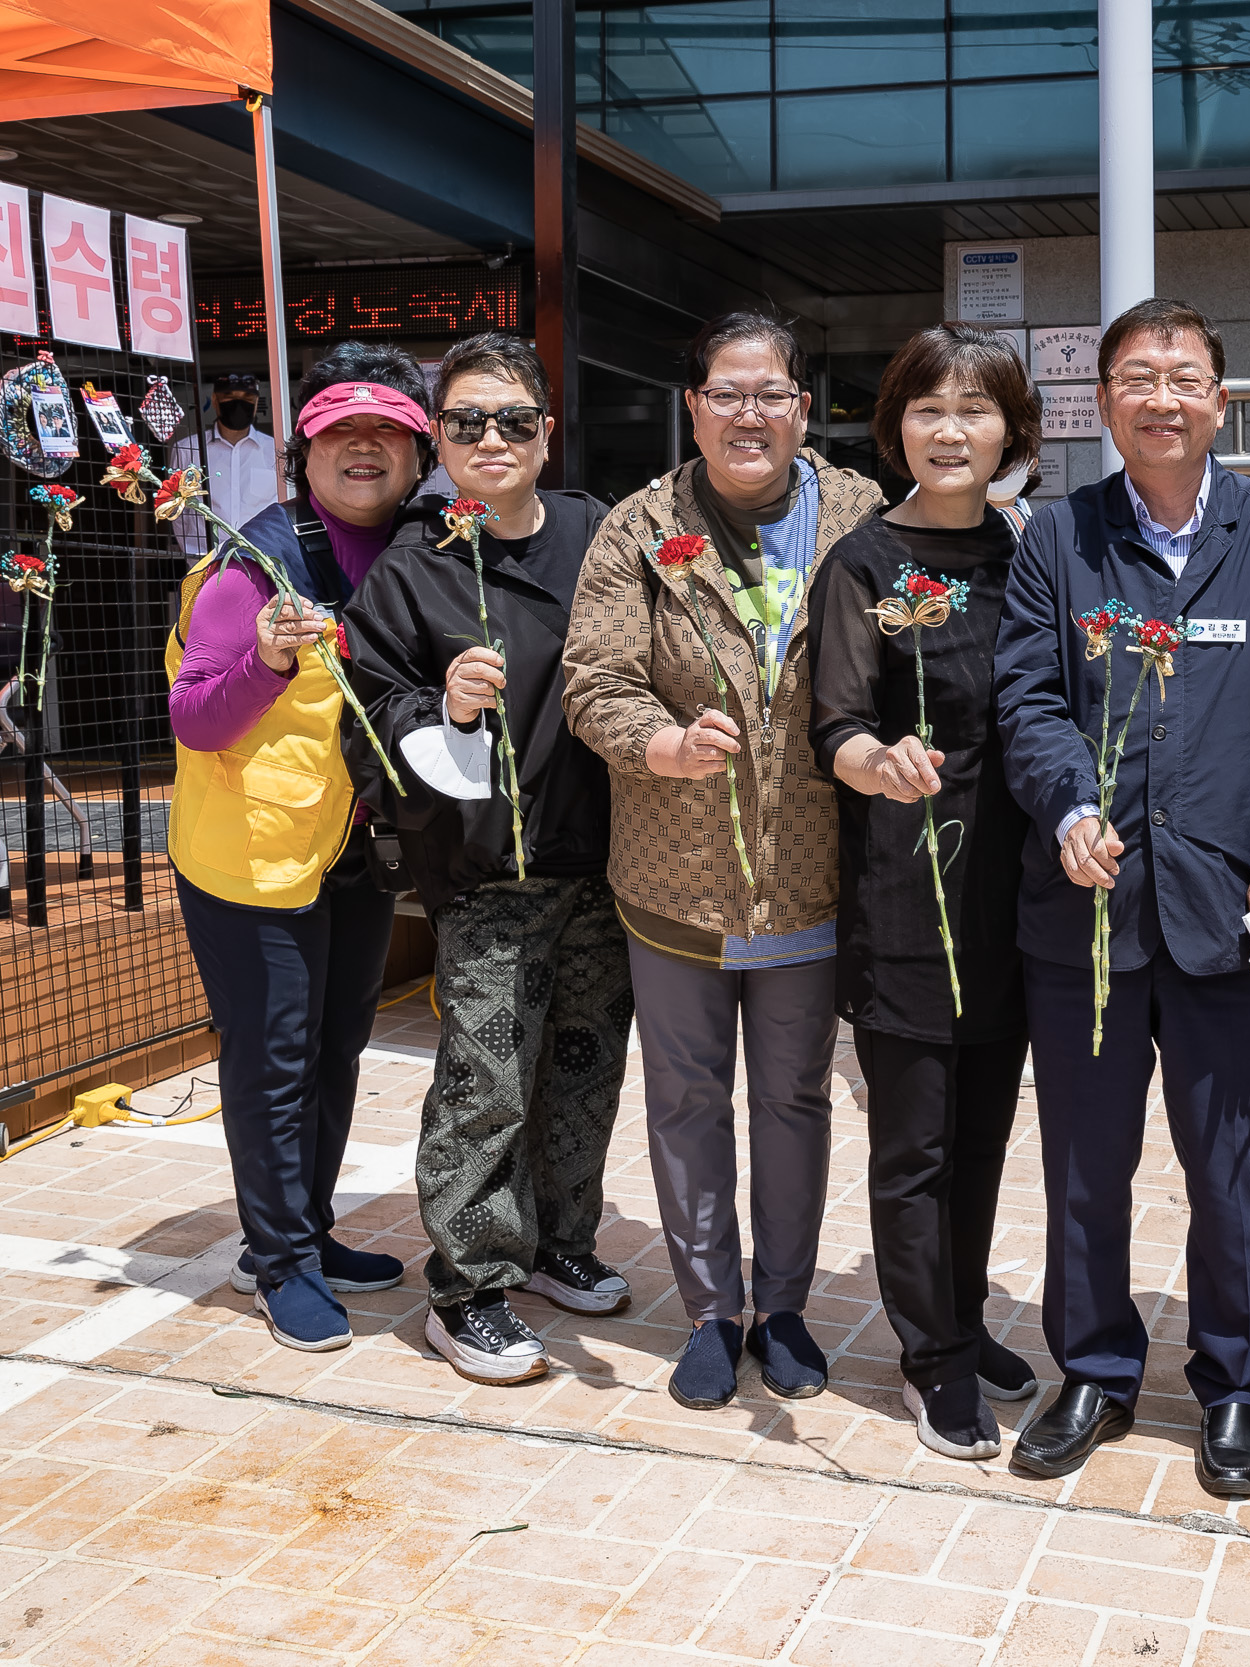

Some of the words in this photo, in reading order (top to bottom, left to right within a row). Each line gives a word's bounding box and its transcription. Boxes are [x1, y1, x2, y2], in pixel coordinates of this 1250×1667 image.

[965, 255, 987, 264] CCTV
[1045, 365, 1091, 376] 평생학습관
[1043, 408, 1095, 418] One-stop
[1046, 419, 1092, 429] 지원센터
[1208, 623, 1241, 632] 김경호
